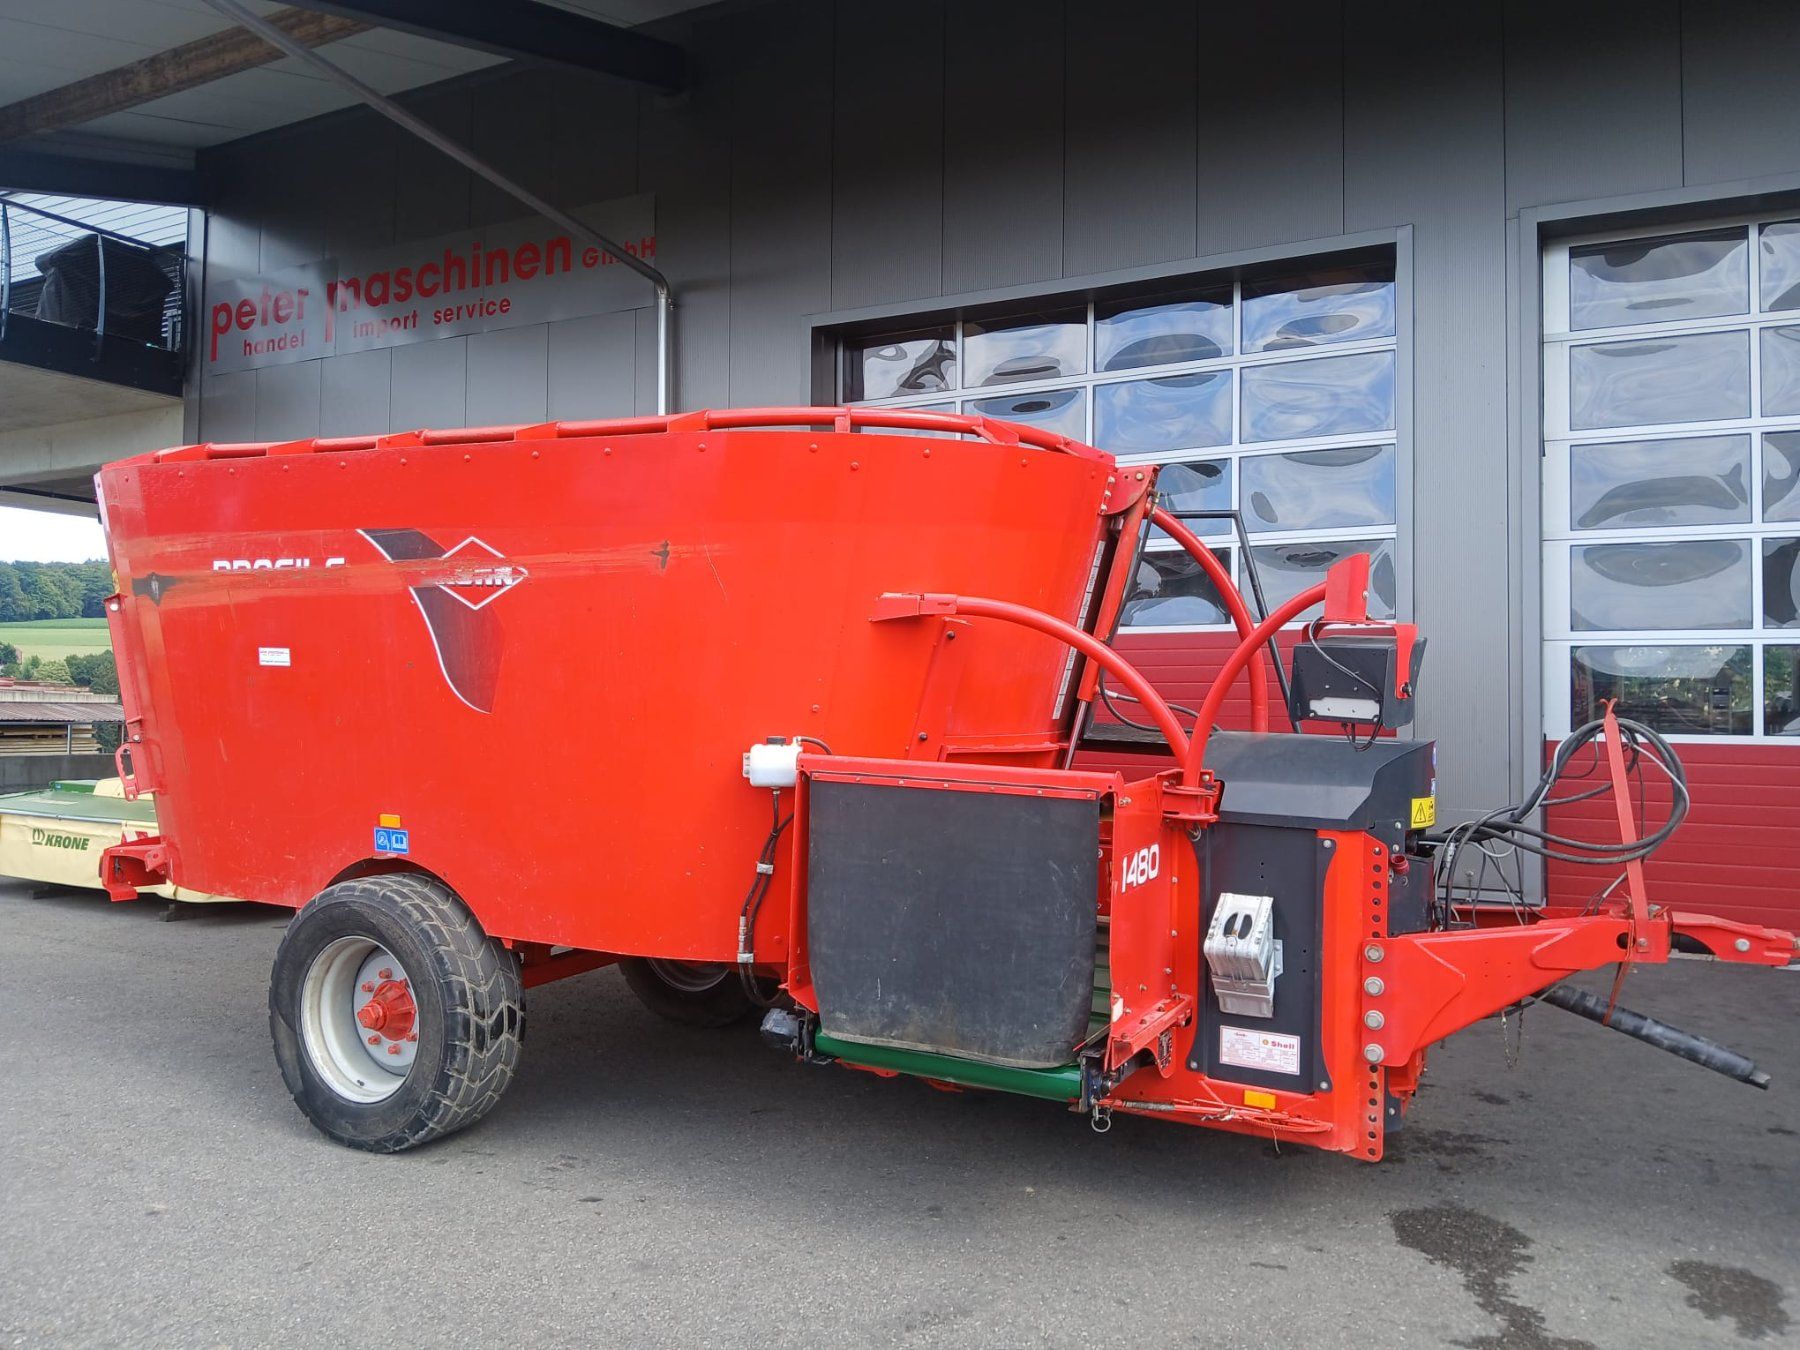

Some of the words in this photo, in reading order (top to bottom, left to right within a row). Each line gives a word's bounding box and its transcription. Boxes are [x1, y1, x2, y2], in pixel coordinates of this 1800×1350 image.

[210, 282, 309, 362] peter
[325, 236, 571, 343] maschinen
[243, 329, 305, 356] handel
[353, 308, 418, 338] import
[433, 297, 512, 326] service
[44, 834, 90, 850] KRONE
[1121, 843, 1160, 893] 1480
[1271, 1040, 1295, 1050] Shell
